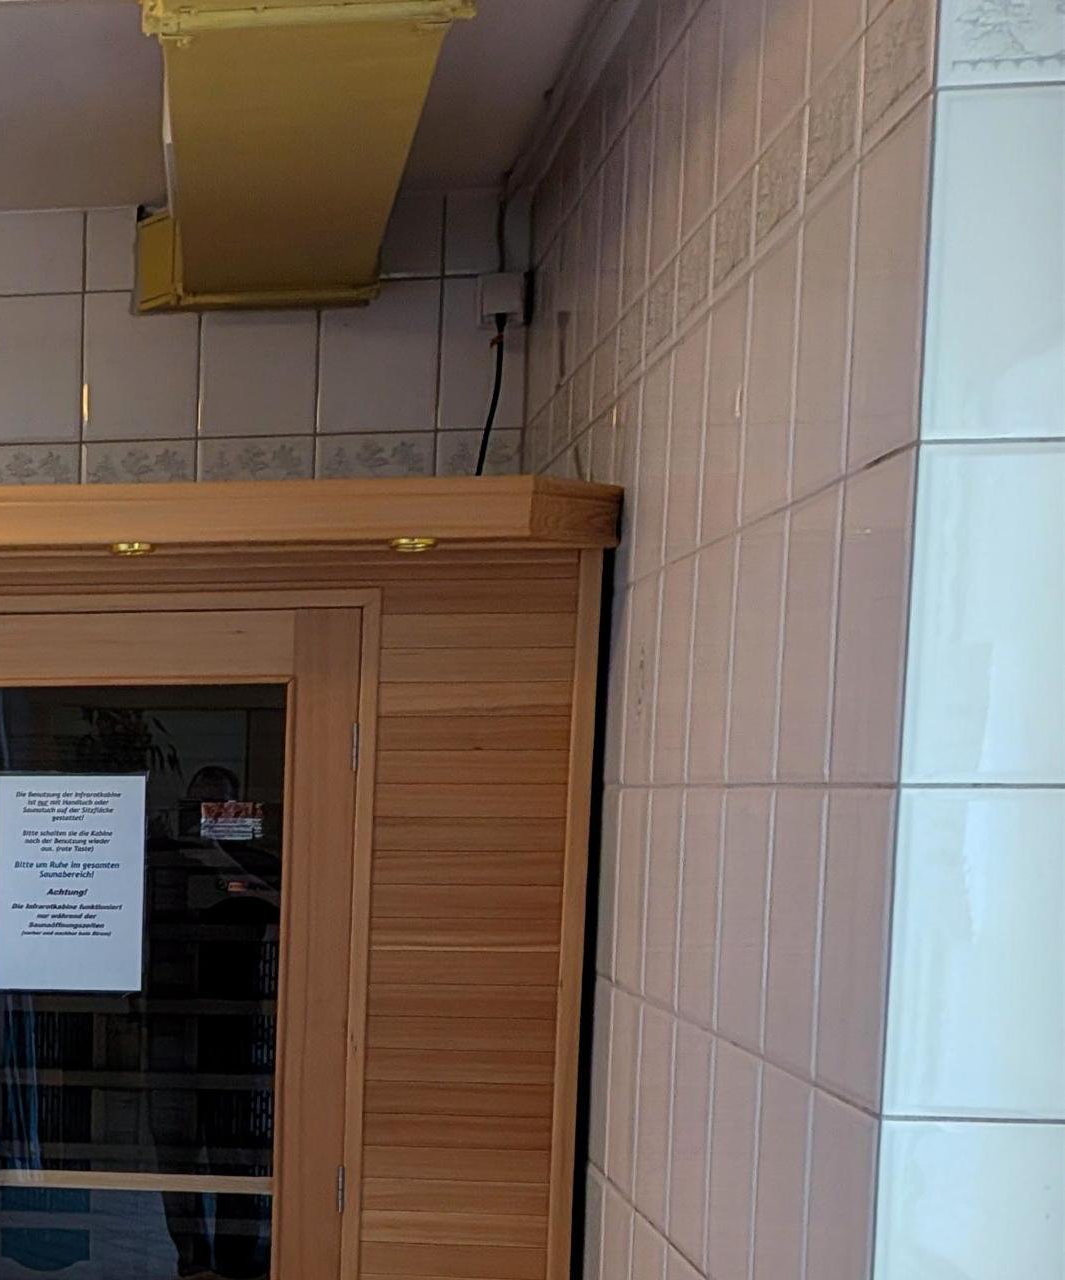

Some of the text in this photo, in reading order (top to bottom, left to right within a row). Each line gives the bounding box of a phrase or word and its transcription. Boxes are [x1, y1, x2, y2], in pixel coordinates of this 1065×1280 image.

[82, 862, 120, 870] gesamten
[39, 870, 94, 879] Saunabereich!
[47, 888, 88, 897] Achtung!
